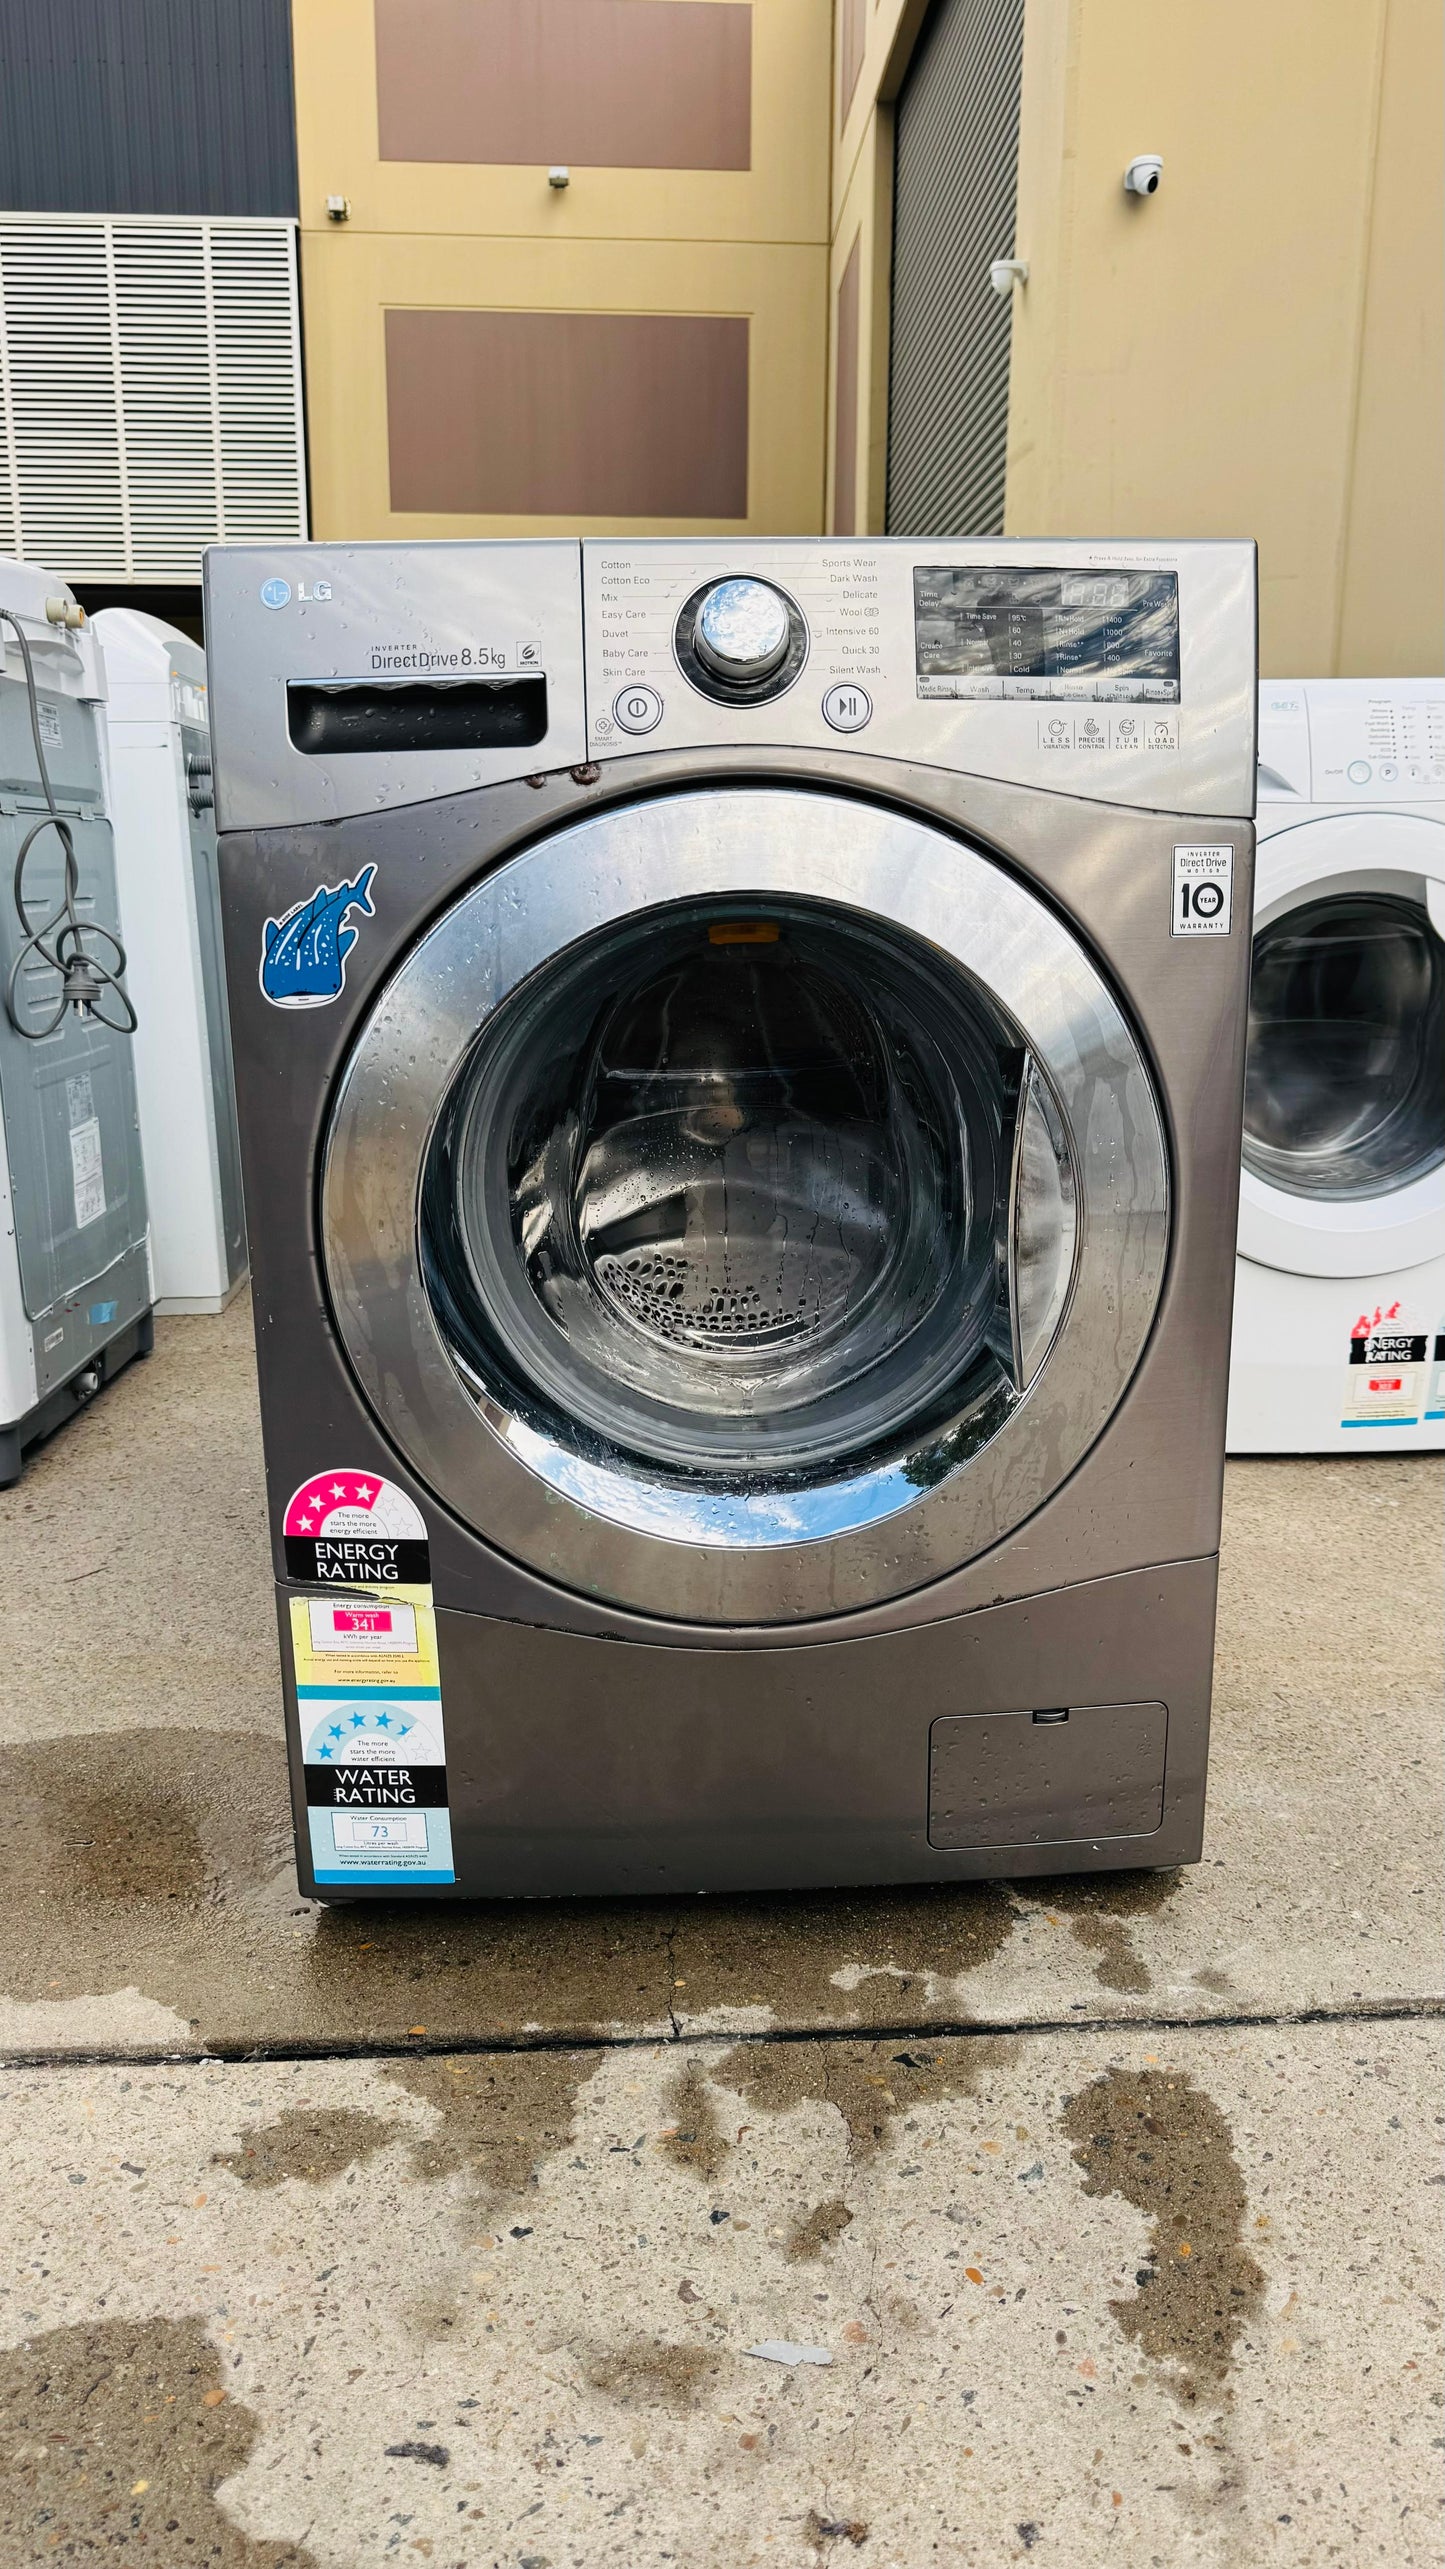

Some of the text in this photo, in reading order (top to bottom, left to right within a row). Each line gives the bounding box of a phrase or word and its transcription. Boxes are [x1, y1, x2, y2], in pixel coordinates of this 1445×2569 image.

[601, 561, 631, 569] Cotton
[822, 559, 877, 568] Sports Wear
[601, 577, 650, 585] Cotton Eco
[830, 574, 878, 583] Dark Wash
[298, 581, 332, 602] LG
[843, 590, 878, 599] Delicate
[601, 593, 618, 602] Mix
[919, 600, 941, 608] Delay
[602, 610, 646, 620] Easy Care
[839, 607, 863, 616] Wool
[602, 629, 629, 638] Duvet
[826, 627, 880, 636] Intensive 60
[371, 643, 417, 651] INVERTER
[842, 646, 880, 656] Quick 30
[602, 649, 649, 659] Baby Care
[1144, 650, 1174, 658] Favorite
[602, 668, 646, 677] Skin Care
[829, 665, 881, 675] Silent Wash
[1013, 665, 1030, 673] Cold
[1181, 858, 1227, 867] Direct Drive
[1181, 882, 1224, 918] 10
[1366, 1350, 1412, 1362] RATING
[330, 1528, 352, 1536] energy
[314, 1542, 399, 1561] ENERGY
[316, 1561, 399, 1580] RATING
[352, 1618, 376, 1631] 341
[335, 1769, 413, 1785] WATER
[335, 1788, 416, 1803] RATING
[371, 1826, 389, 1837] 73
